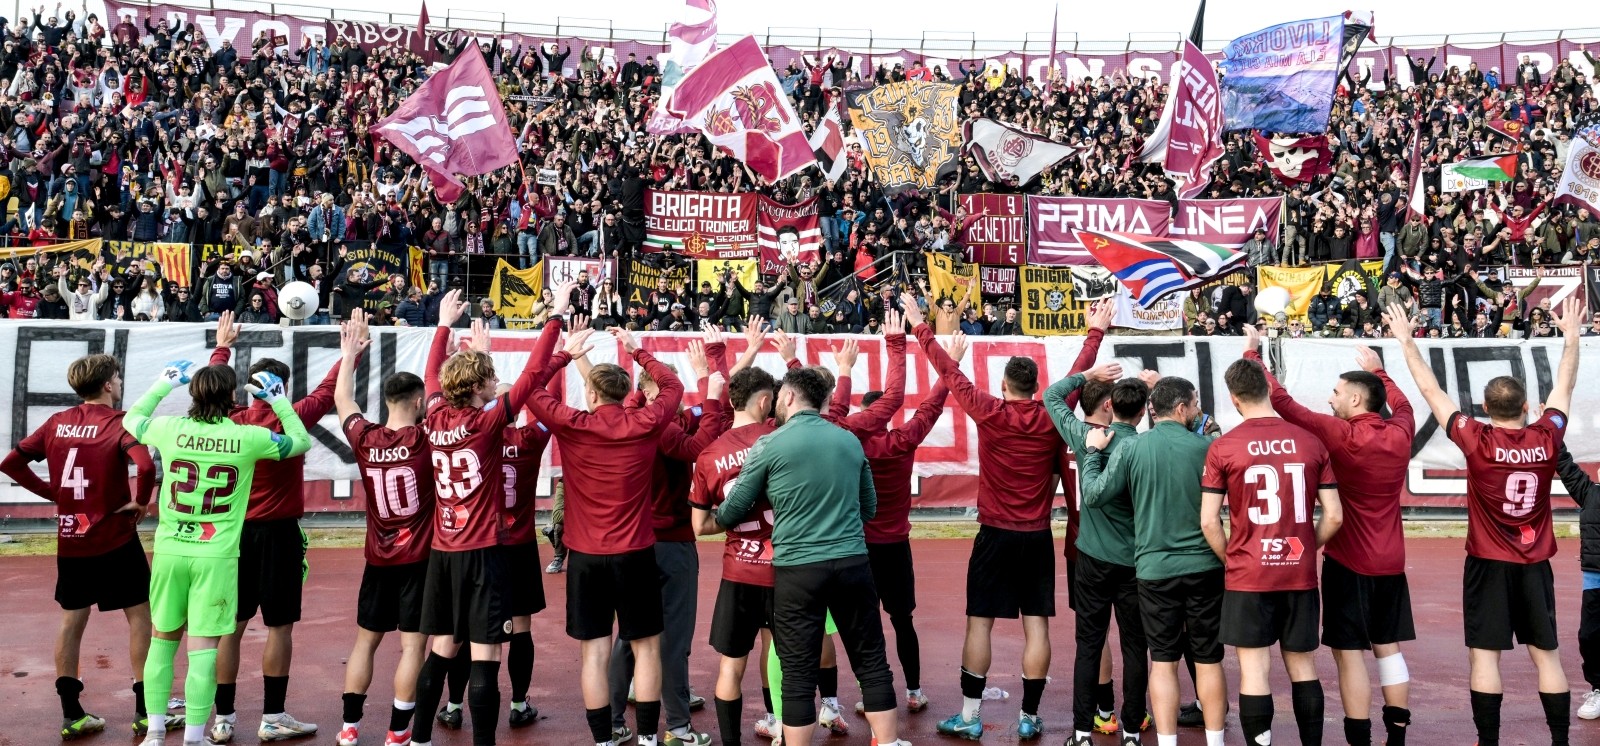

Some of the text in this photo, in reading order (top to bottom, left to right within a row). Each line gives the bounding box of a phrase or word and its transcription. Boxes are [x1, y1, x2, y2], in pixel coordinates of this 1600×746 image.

[1568, 182, 1599, 203] 1915
[652, 192, 741, 218] BRIGATA
[699, 219, 749, 233] TRONIERI
[968, 216, 1024, 243] RENETICI
[1038, 203, 1268, 237] PRIMA LINEA
[716, 234, 754, 242] SEZIONE
[719, 249, 754, 258] GIOVANI
[1008, 245, 1018, 263] 5
[1025, 268, 1072, 284] ORIGIN
[1028, 312, 1086, 331] TRIKALA
[56, 423, 98, 439] RISALITI
[176, 433, 241, 454] CARDELLI
[1247, 439, 1297, 456] GUCCI
[368, 445, 410, 463] RUSSO
[1495, 446, 1548, 464] DIONISI
[61, 447, 90, 500] 4
[431, 448, 483, 500] 33
[168, 458, 240, 516] 22
[365, 466, 420, 519] 10
[1244, 463, 1307, 525] 31
[1502, 471, 1539, 517] 9
[176, 520, 196, 534] TS
[740, 537, 760, 553] TS
